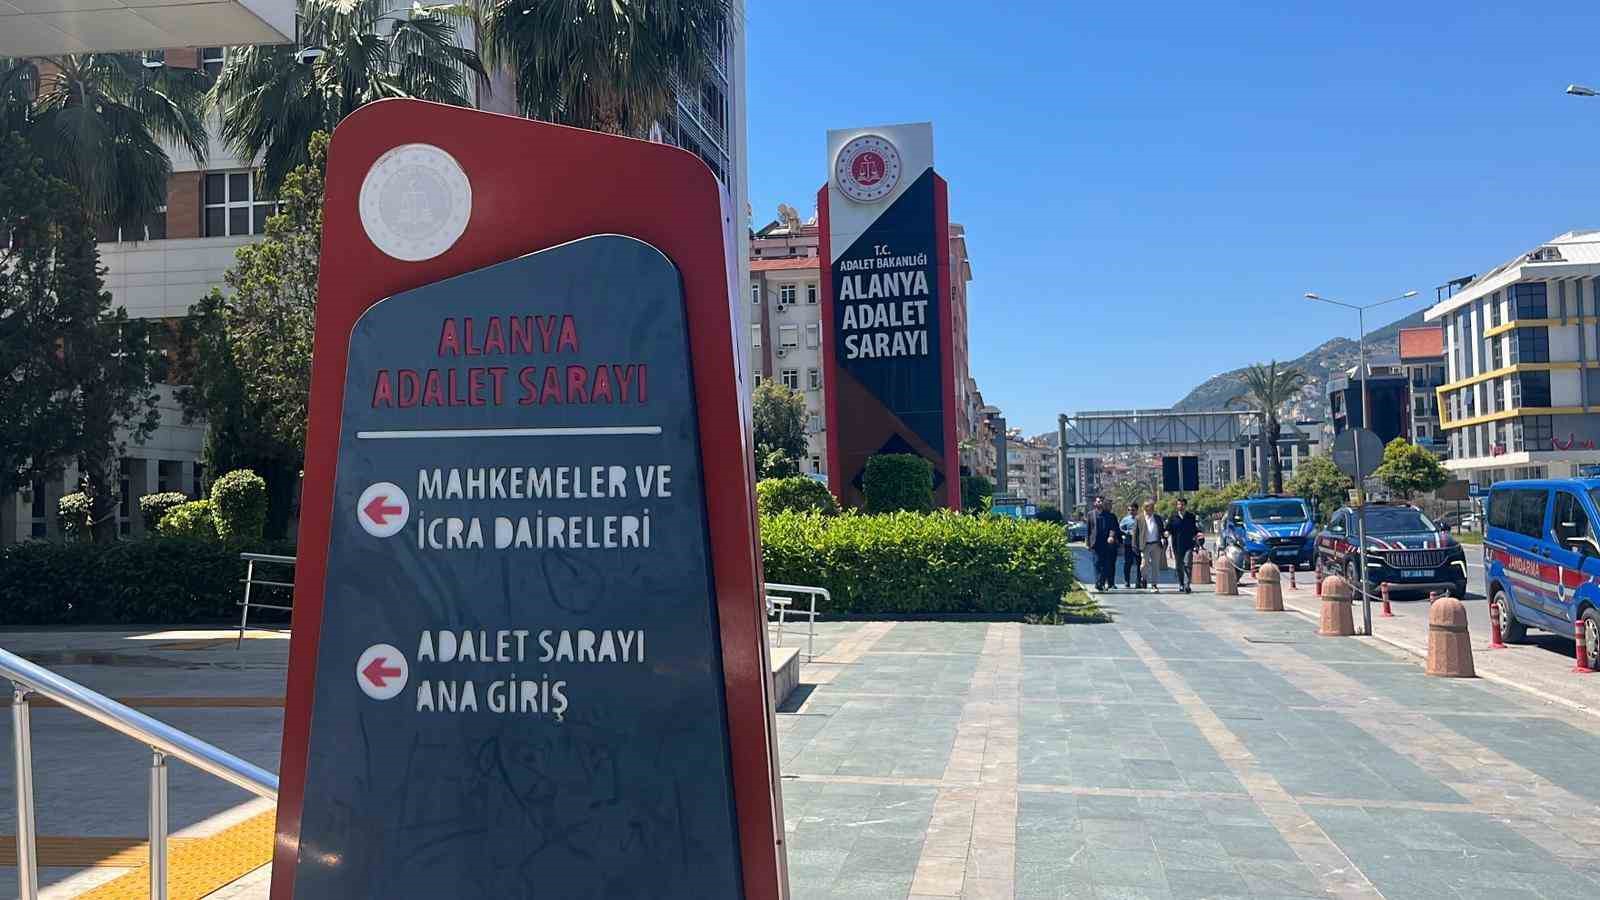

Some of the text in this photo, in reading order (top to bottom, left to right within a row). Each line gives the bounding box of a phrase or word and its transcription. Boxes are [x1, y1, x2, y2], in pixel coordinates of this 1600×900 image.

[840, 254, 928, 271] ADALET BAKANLIĞI
[874, 245, 892, 256] T.C.
[840, 271, 929, 301] ALANYA
[842, 301, 928, 330] ADALET
[438, 314, 580, 357] ALANYA
[845, 330, 928, 359] SARAYI
[371, 364, 649, 409] ADALET SARAYI
[417, 465, 673, 501] MAHKEMELER VE
[417, 508, 651, 550] İCRA DAİRELERİ
[1508, 554, 1541, 578] JANDARMA
[416, 630, 646, 663] ADALET SARAYI
[416, 673, 568, 722] ANA GİRİŞ
